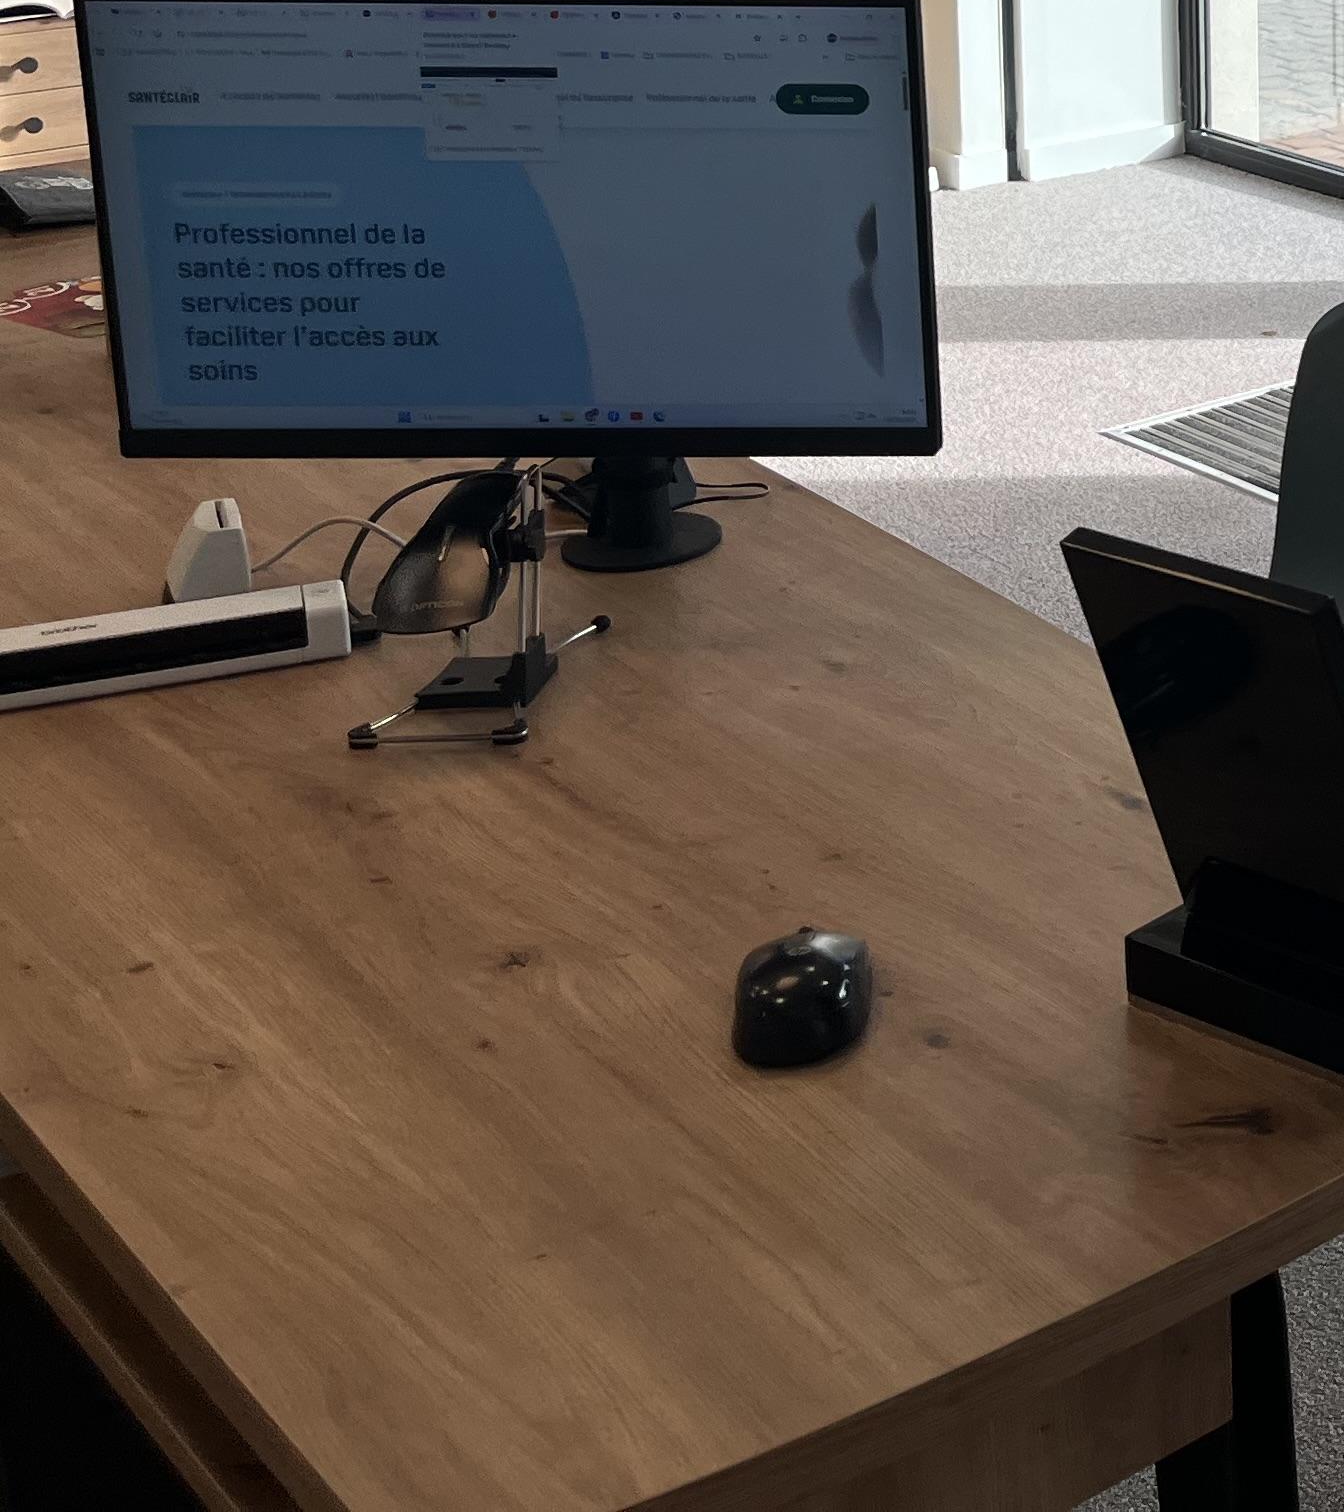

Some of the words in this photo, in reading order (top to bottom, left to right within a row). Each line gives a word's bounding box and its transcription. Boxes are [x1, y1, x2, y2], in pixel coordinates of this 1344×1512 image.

[174, 222, 357, 245] Professionnel
[364, 223, 396, 245] de
[403, 223, 426, 245] la
[177, 256, 251, 279] santé
[273, 261, 320, 279] nos
[327, 257, 407, 279] offres
[414, 258, 446, 279] de
[180, 292, 293, 314] services
[300, 295, 361, 317] pour
[184, 325, 287, 347] faciliter
[293, 325, 386, 347] l'accès
[392, 330, 440, 347] aux
[188, 360, 258, 381] soins
